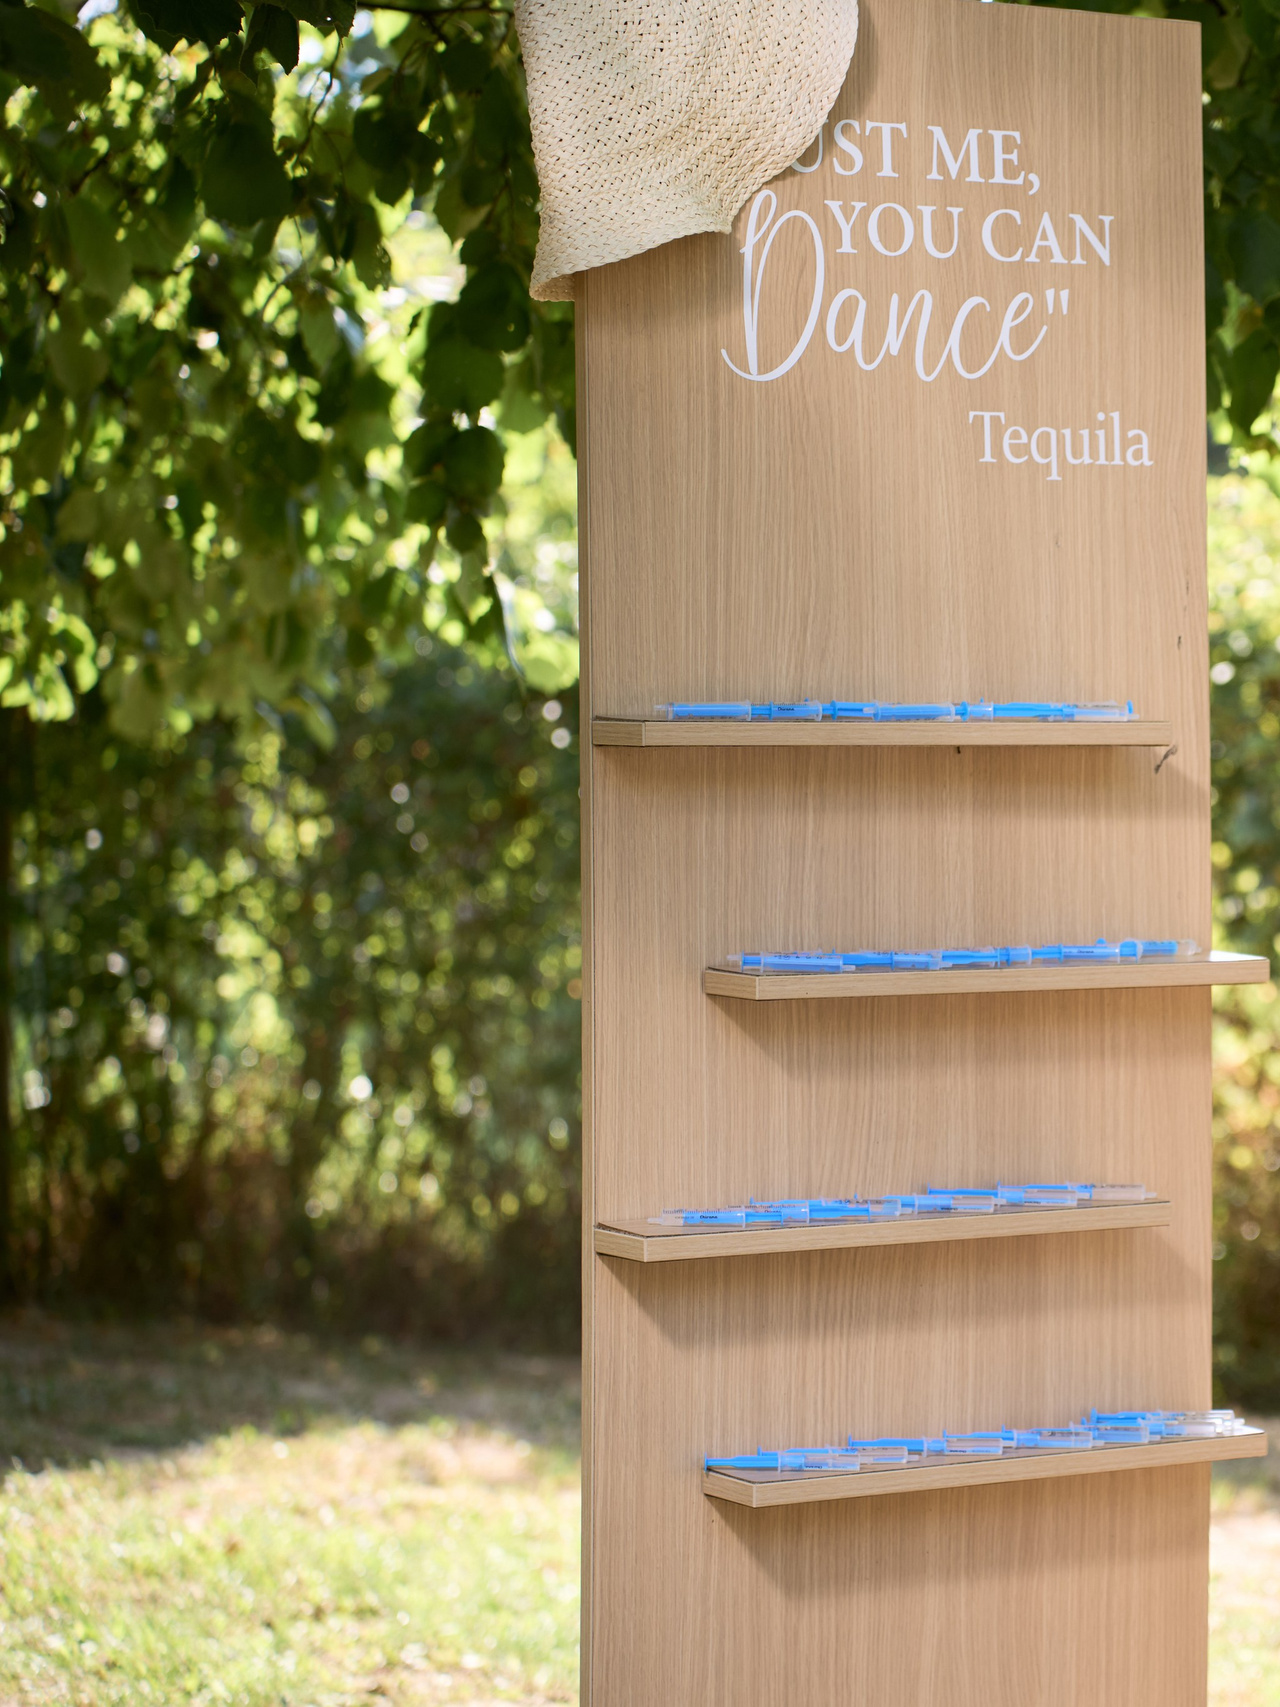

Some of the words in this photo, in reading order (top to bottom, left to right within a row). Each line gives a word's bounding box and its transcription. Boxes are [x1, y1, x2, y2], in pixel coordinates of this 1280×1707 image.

[926, 125, 1040, 196] ME,
[823, 200, 964, 259] YOU
[981, 208, 1115, 267] CAN
[720, 189, 1070, 382] Dance"
[968, 410, 1154, 481] Tequila
